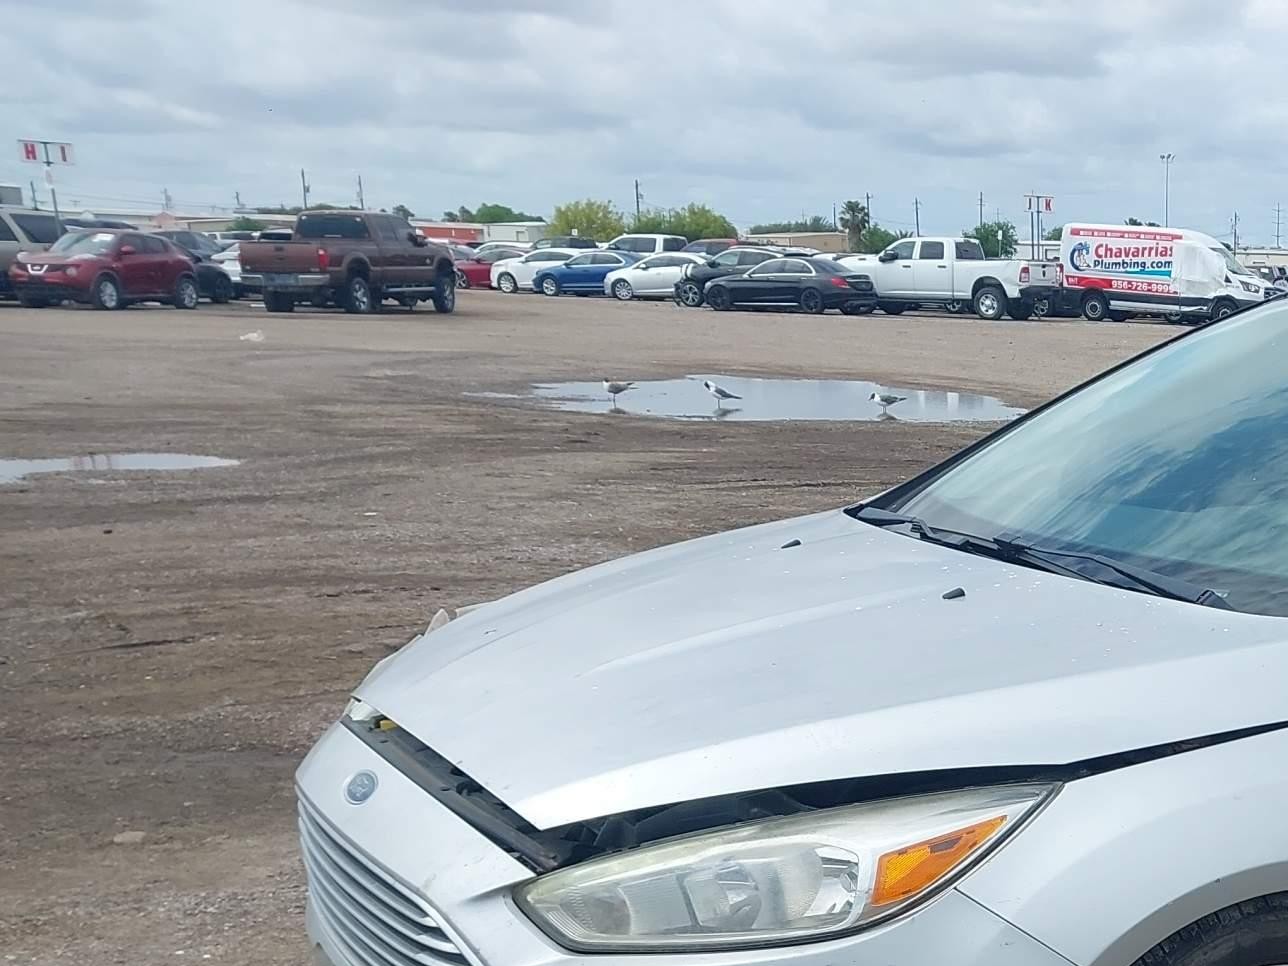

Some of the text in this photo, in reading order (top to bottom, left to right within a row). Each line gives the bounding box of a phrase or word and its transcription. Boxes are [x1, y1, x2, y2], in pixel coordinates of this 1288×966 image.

[23, 143, 37, 160] H
[1045, 198, 1052, 211] K
[1093, 259, 1173, 272] Plumbing.com
